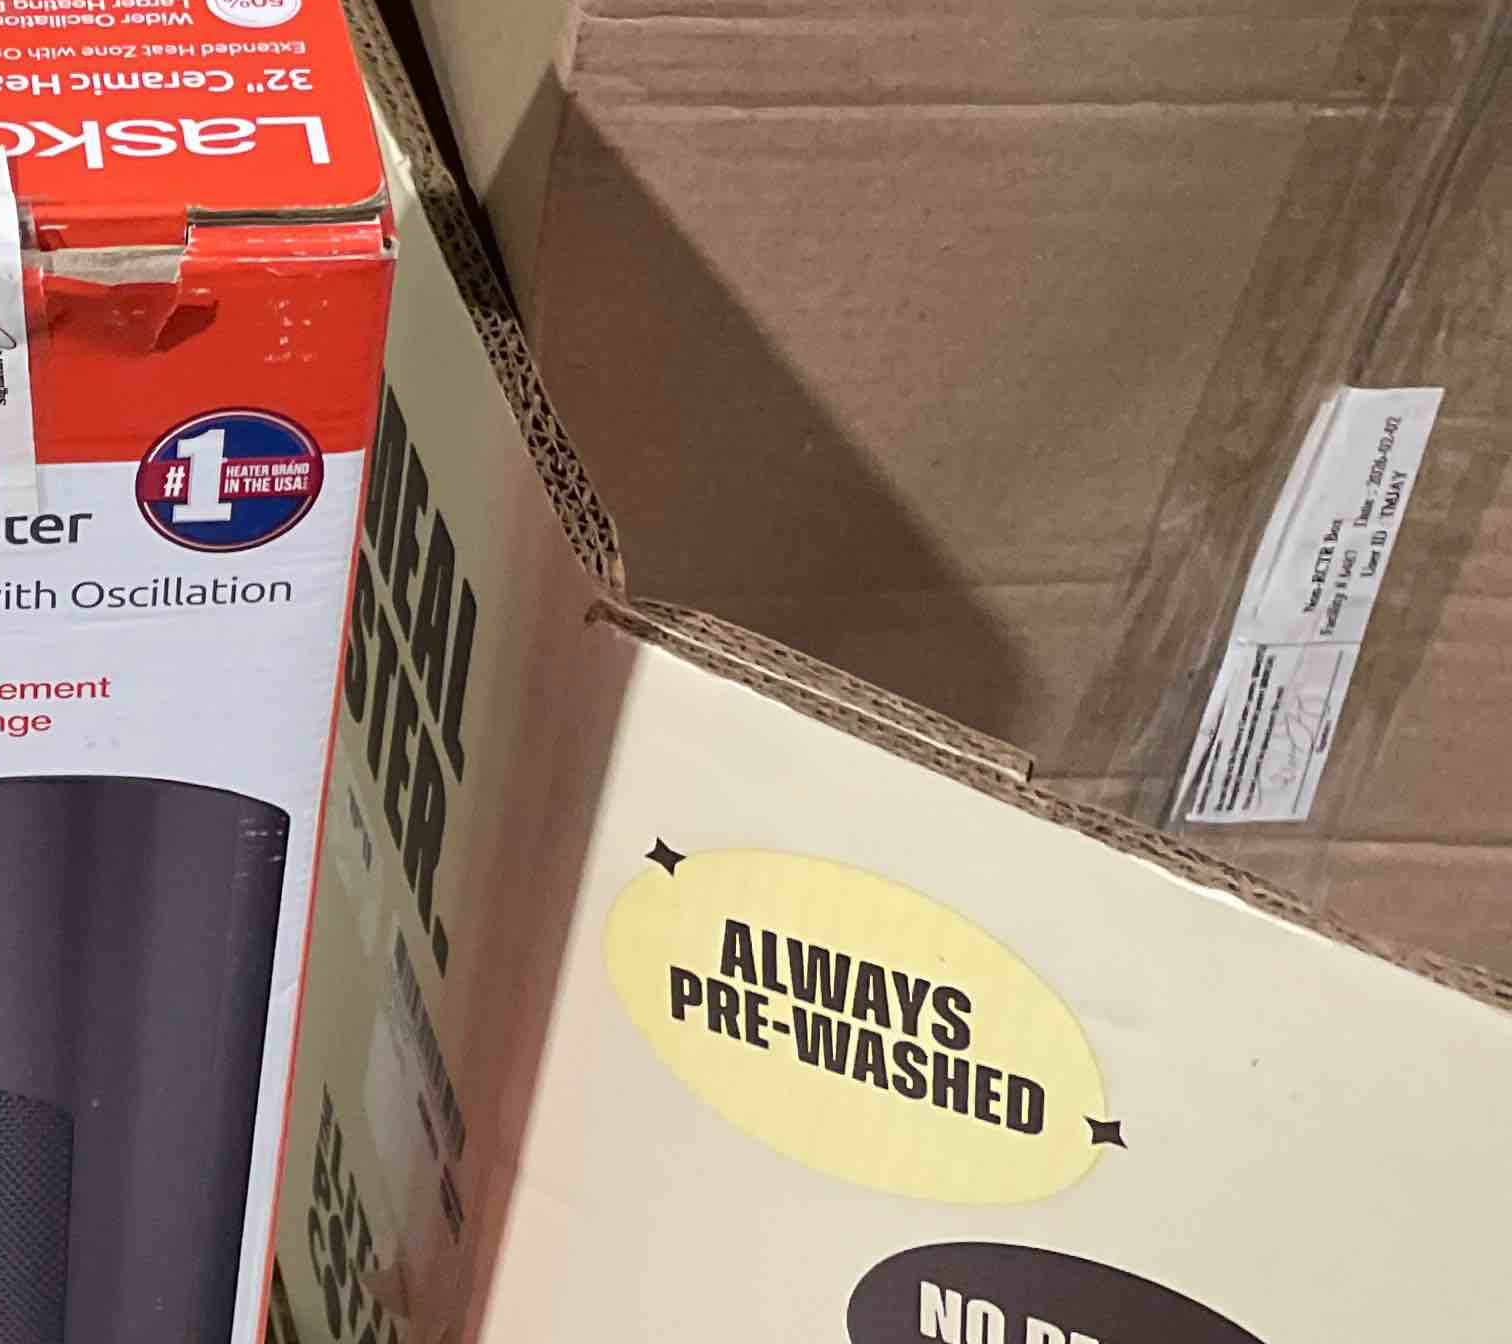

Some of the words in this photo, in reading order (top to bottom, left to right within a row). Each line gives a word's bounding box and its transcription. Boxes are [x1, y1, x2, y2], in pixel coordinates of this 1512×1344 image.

[121, 13, 193, 26] Wider
[28, 47, 76, 60] with
[82, 45, 136, 59] Zone
[142, 44, 196, 57] Heat
[201, 41, 306, 56] Extended
[69, 71, 234, 95] Ceramic
[247, 68, 313, 93] 32"
[172, 429, 232, 523] 1
[226, 465, 269, 476] HEATER
[272, 462, 309, 475] BRAND
[164, 466, 185, 496] #
[224, 479, 240, 493] IN
[243, 478, 271, 492] THE
[72, 576, 293, 610] Oscillation
[719, 917, 972, 1052] ALWAYS
[669, 964, 1046, 1136] PRE-WASHED
